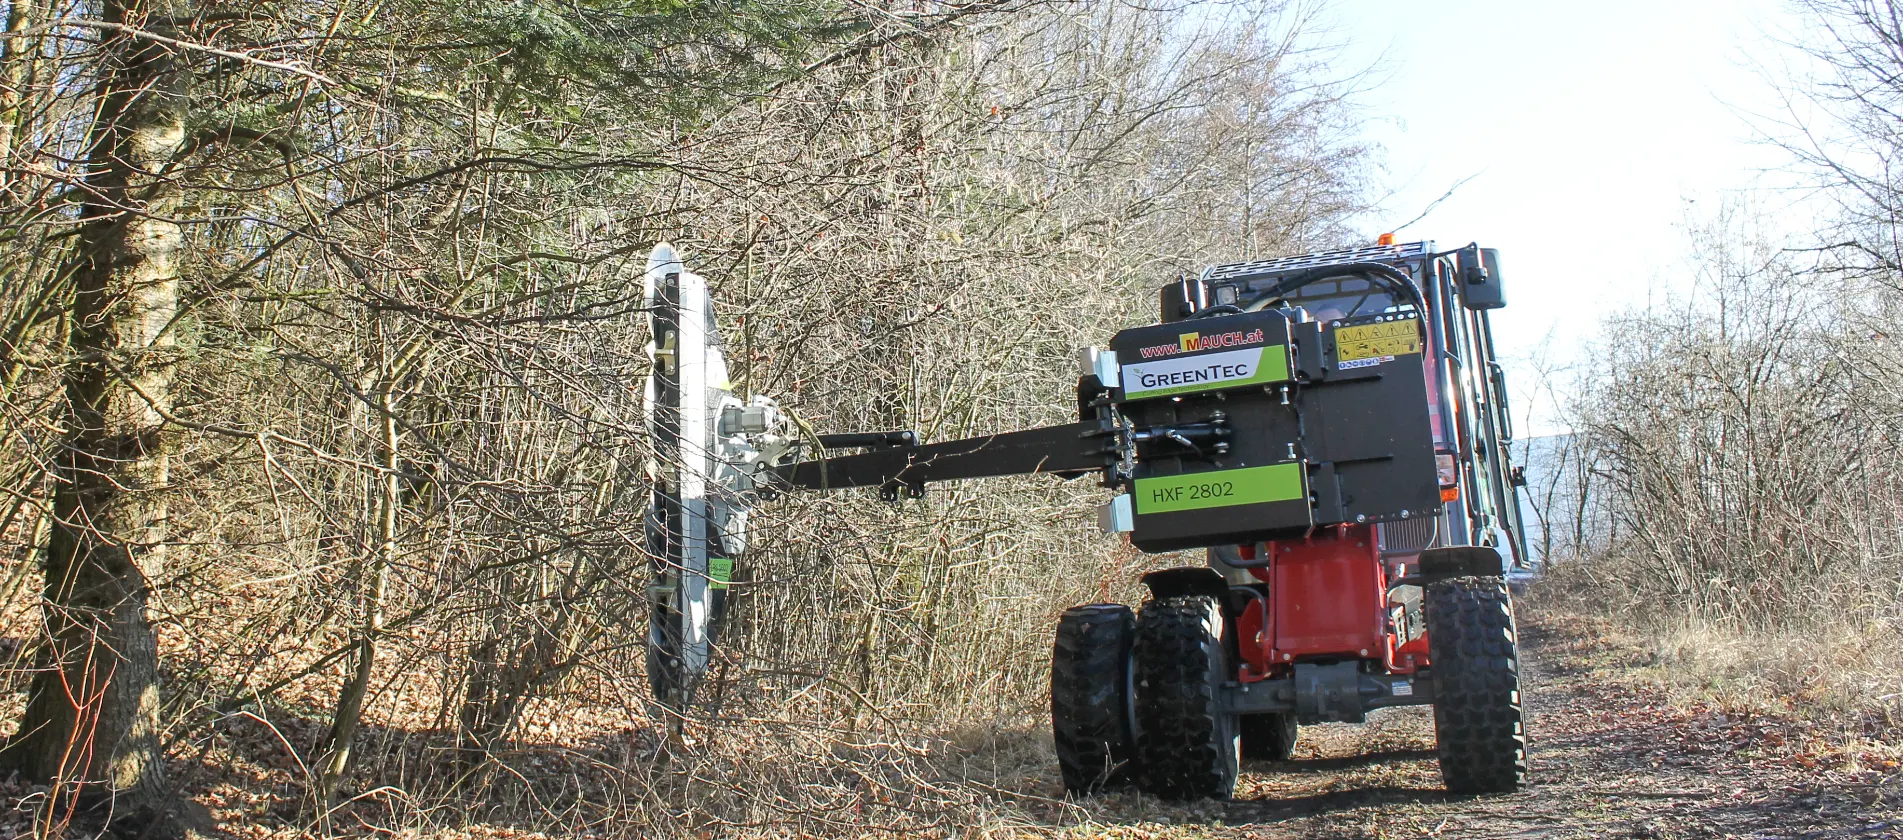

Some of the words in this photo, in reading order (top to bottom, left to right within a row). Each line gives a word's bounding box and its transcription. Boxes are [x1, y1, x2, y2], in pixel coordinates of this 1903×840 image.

[1140, 329, 1264, 358] www.MAUCH.at
[1152, 487, 1184, 503] HXF
[1188, 481, 1234, 500] 2802
